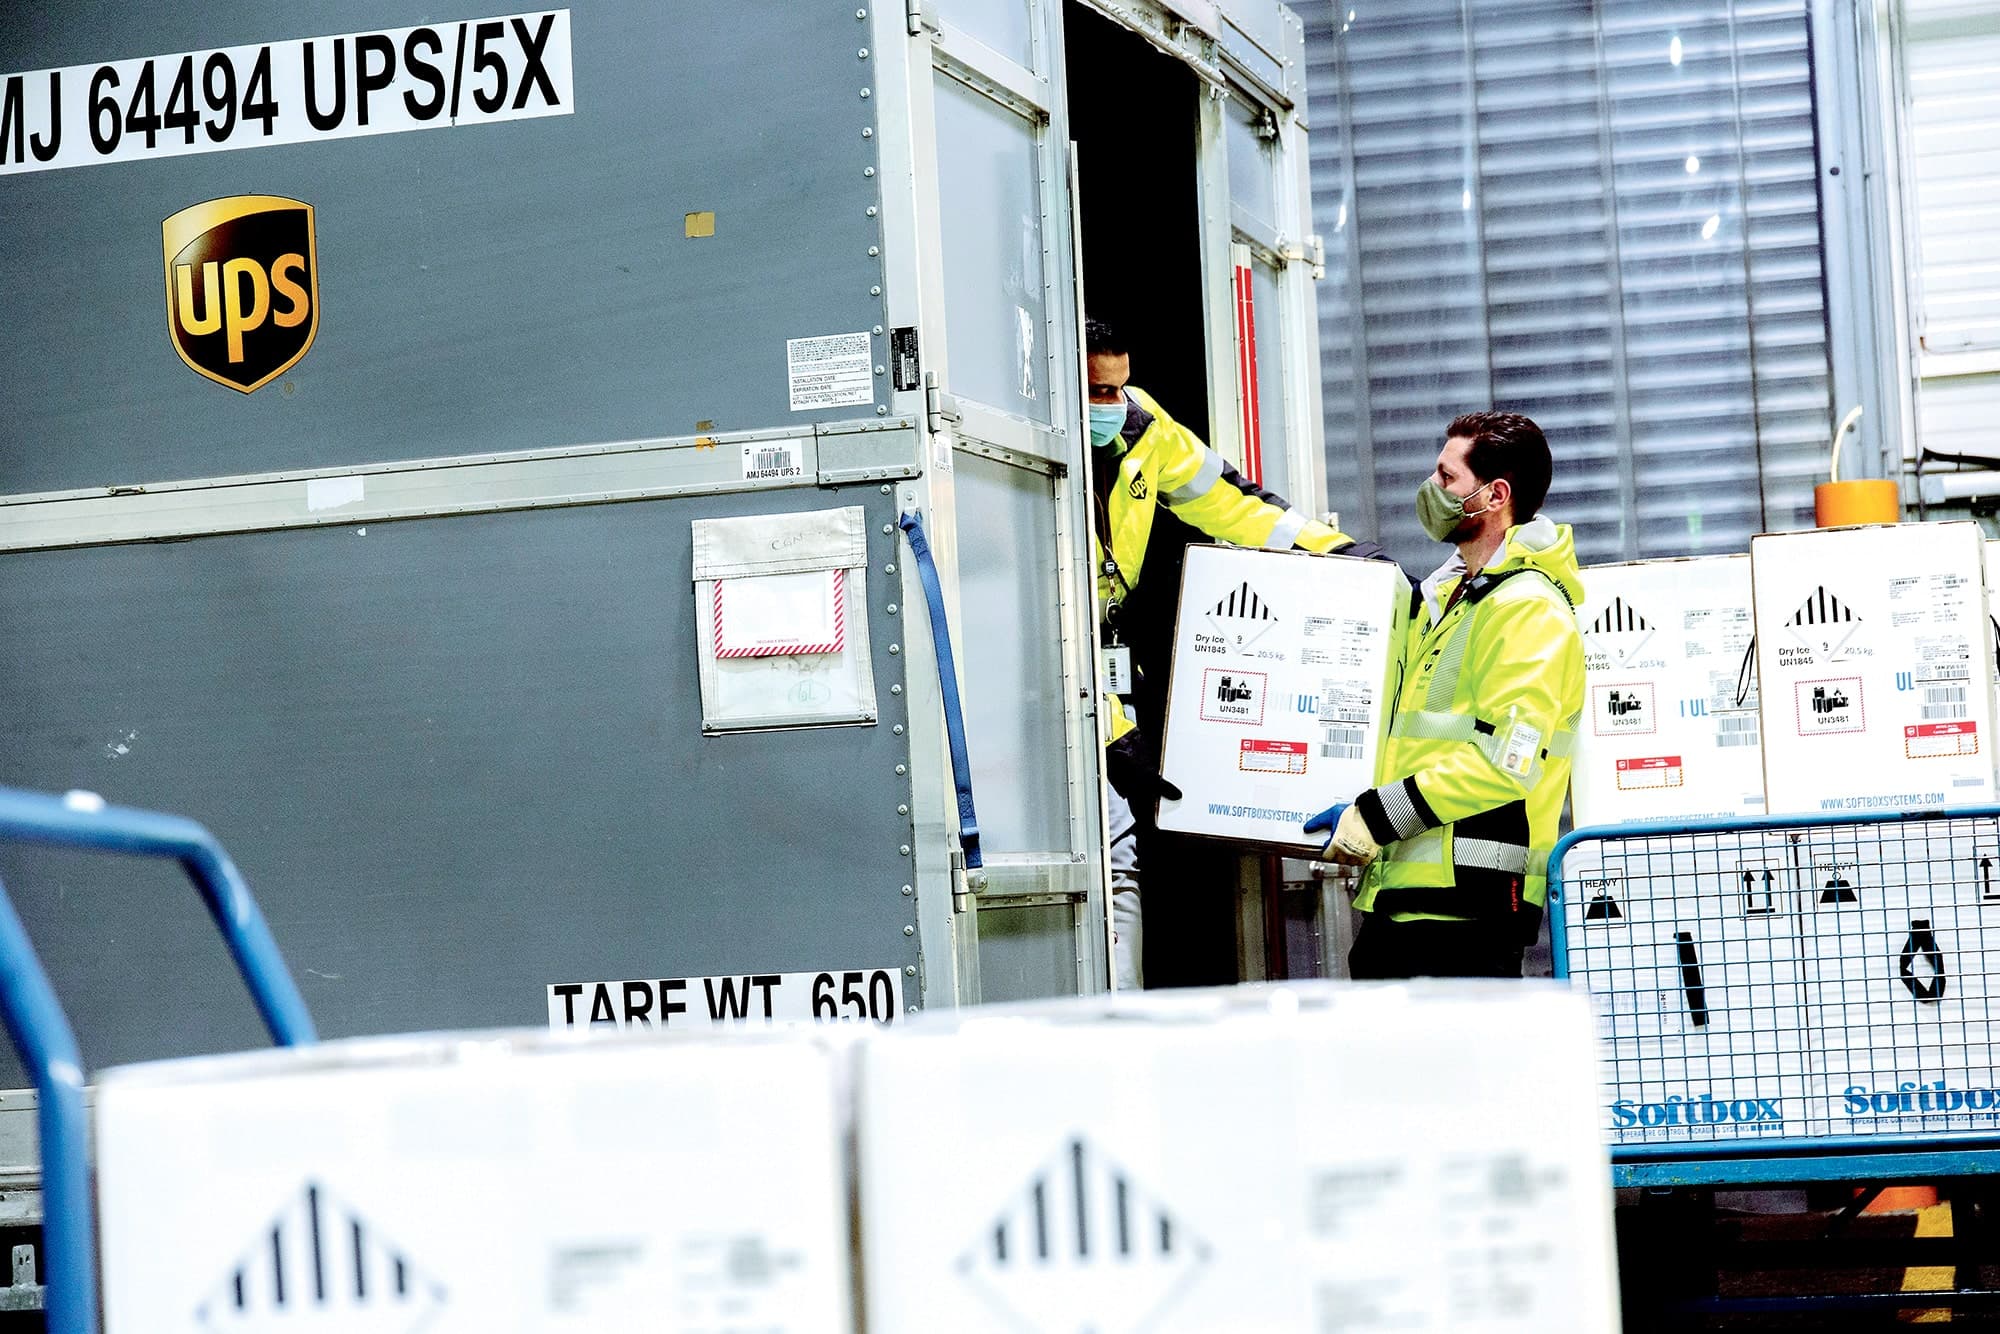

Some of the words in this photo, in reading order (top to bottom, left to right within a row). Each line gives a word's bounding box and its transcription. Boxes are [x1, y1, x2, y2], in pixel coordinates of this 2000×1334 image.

[88, 46, 279, 155] 64494
[302, 14, 561, 131] UPS/5X
[176, 252, 310, 363] ups
[746, 471, 760, 479] AMJ
[761, 469, 779, 478] 64494
[780, 468, 794, 477] UPS
[795, 467, 801, 475] 2
[1195, 634, 1210, 644] Dry
[1211, 635, 1225, 643] Ice
[1194, 644, 1227, 654] UN1845
[1778, 648, 1794, 656] Dry
[1779, 656, 1814, 666] UN1845
[1584, 662, 1610, 671] N1845
[1219, 704, 1249, 714] UN3481
[1612, 718, 1641, 726] UN3481
[1818, 715, 1849, 724] UN3481
[1820, 792, 1945, 809] WWW.SOFTBOXSYSTEMS.COM
[1585, 879, 1617, 888] HEAVY
[811, 970, 894, 1029] 650
[1612, 1093, 1782, 1128] Softbox
